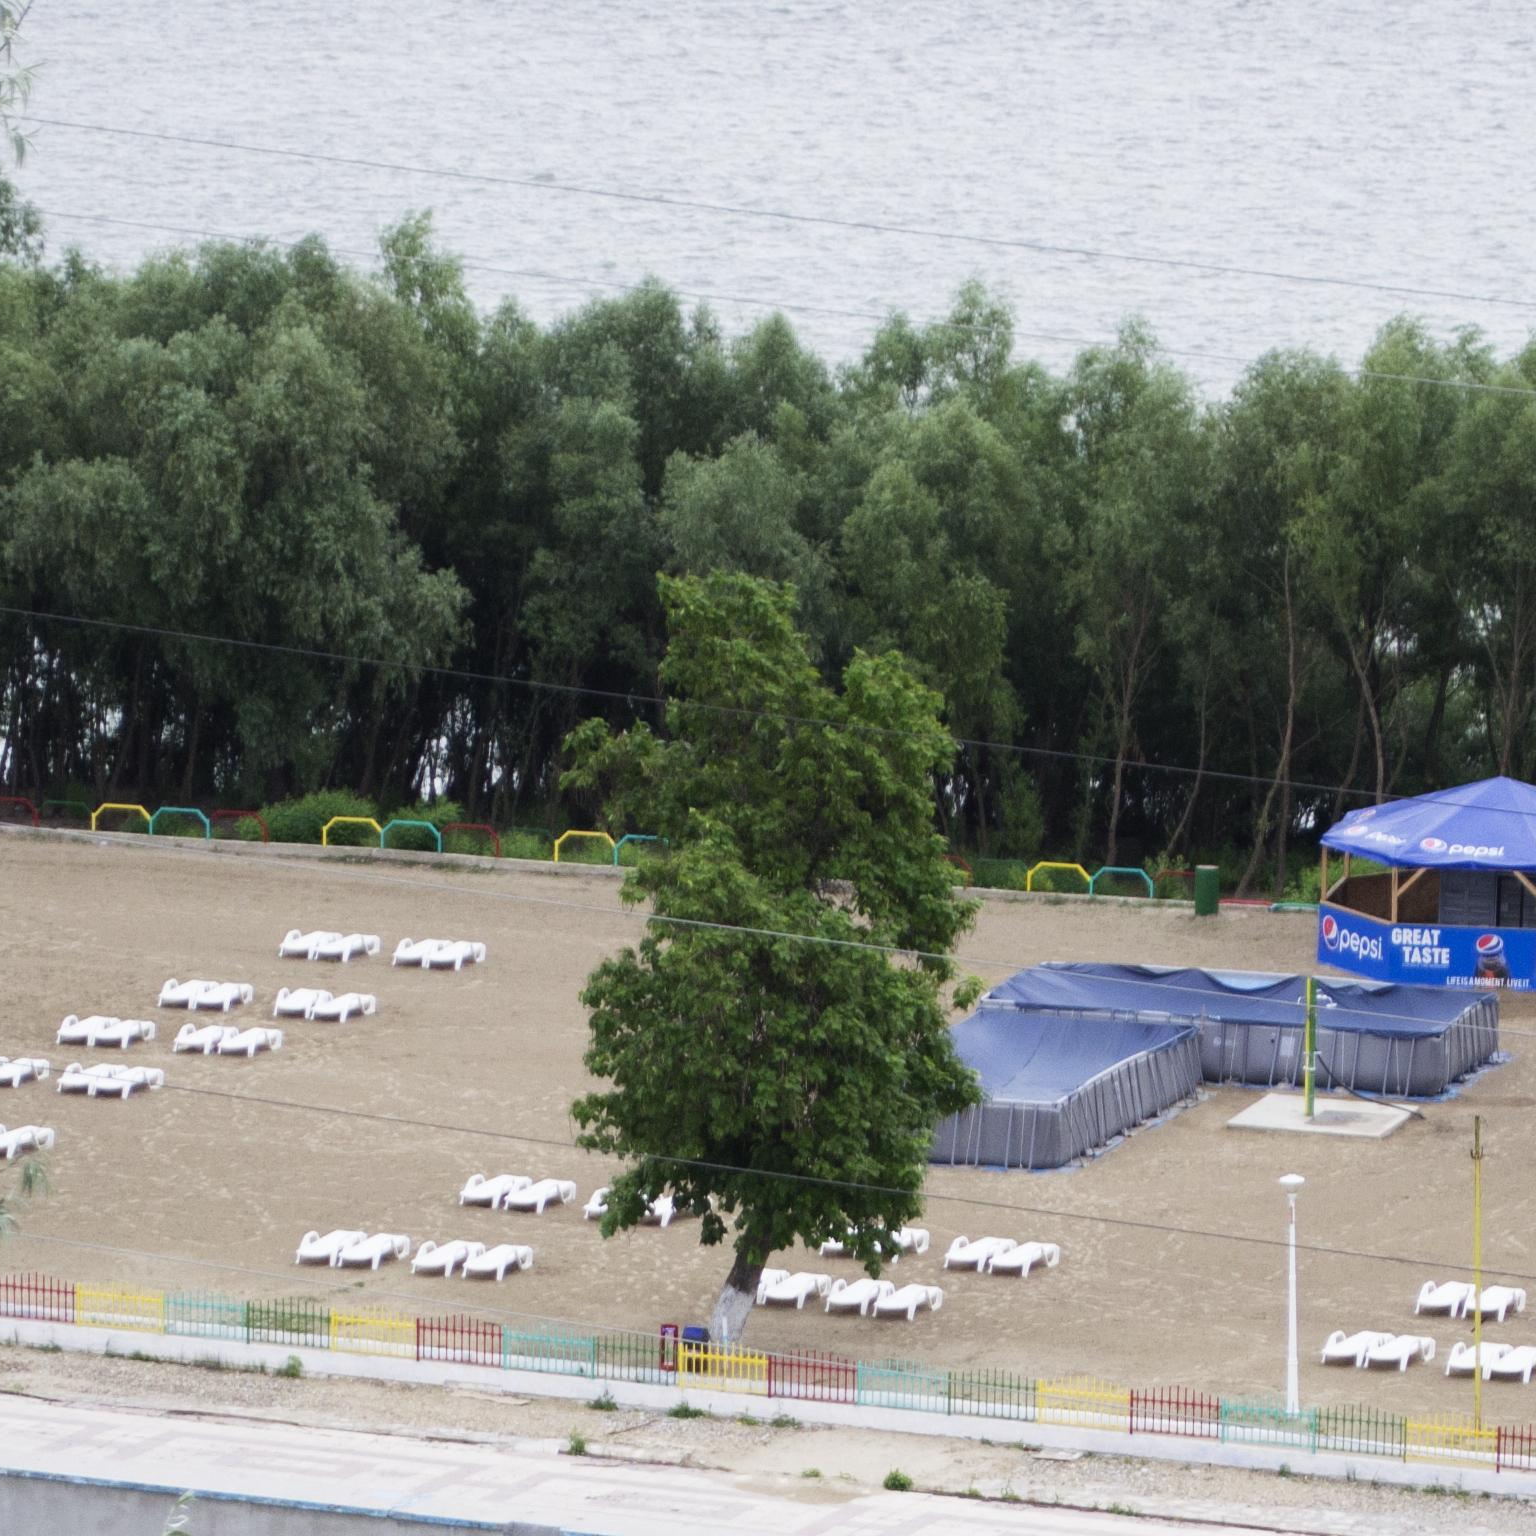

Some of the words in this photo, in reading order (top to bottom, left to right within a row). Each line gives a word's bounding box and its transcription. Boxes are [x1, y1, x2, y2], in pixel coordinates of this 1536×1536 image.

[1449, 844, 1505, 857] pepsi
[1339, 929, 1383, 960] pepsi
[1391, 928, 1441, 946] GREAT
[1402, 946, 1450, 964] TASTE
[1446, 976, 1461, 985] LIFE
